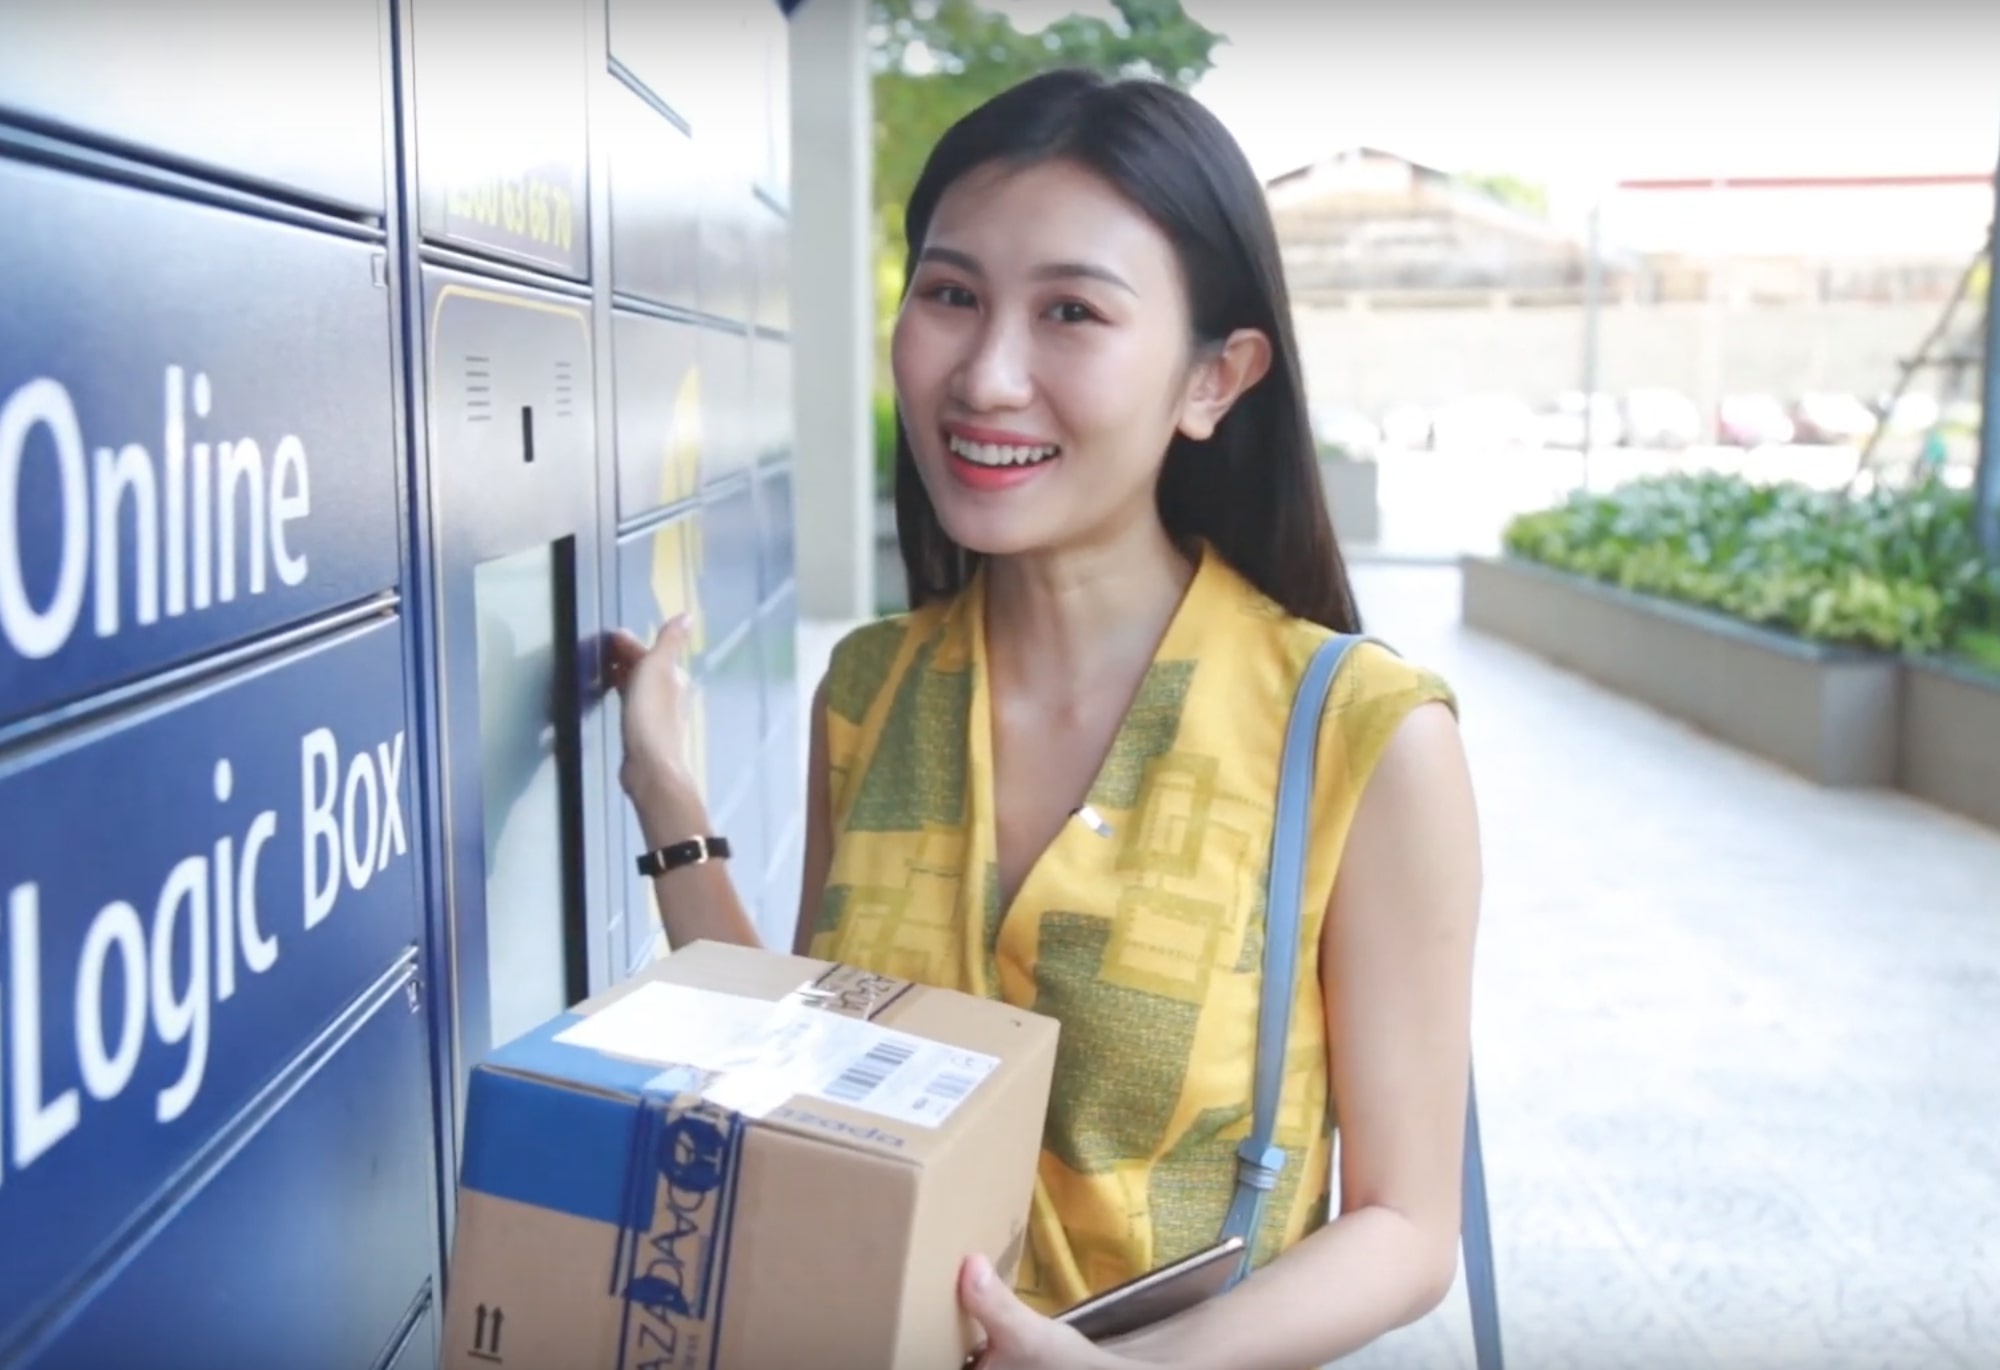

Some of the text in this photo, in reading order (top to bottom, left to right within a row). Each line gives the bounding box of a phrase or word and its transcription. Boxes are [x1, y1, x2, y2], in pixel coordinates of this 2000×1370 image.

[0, 365, 310, 660] Online
[8, 727, 407, 1170] Logic Box
